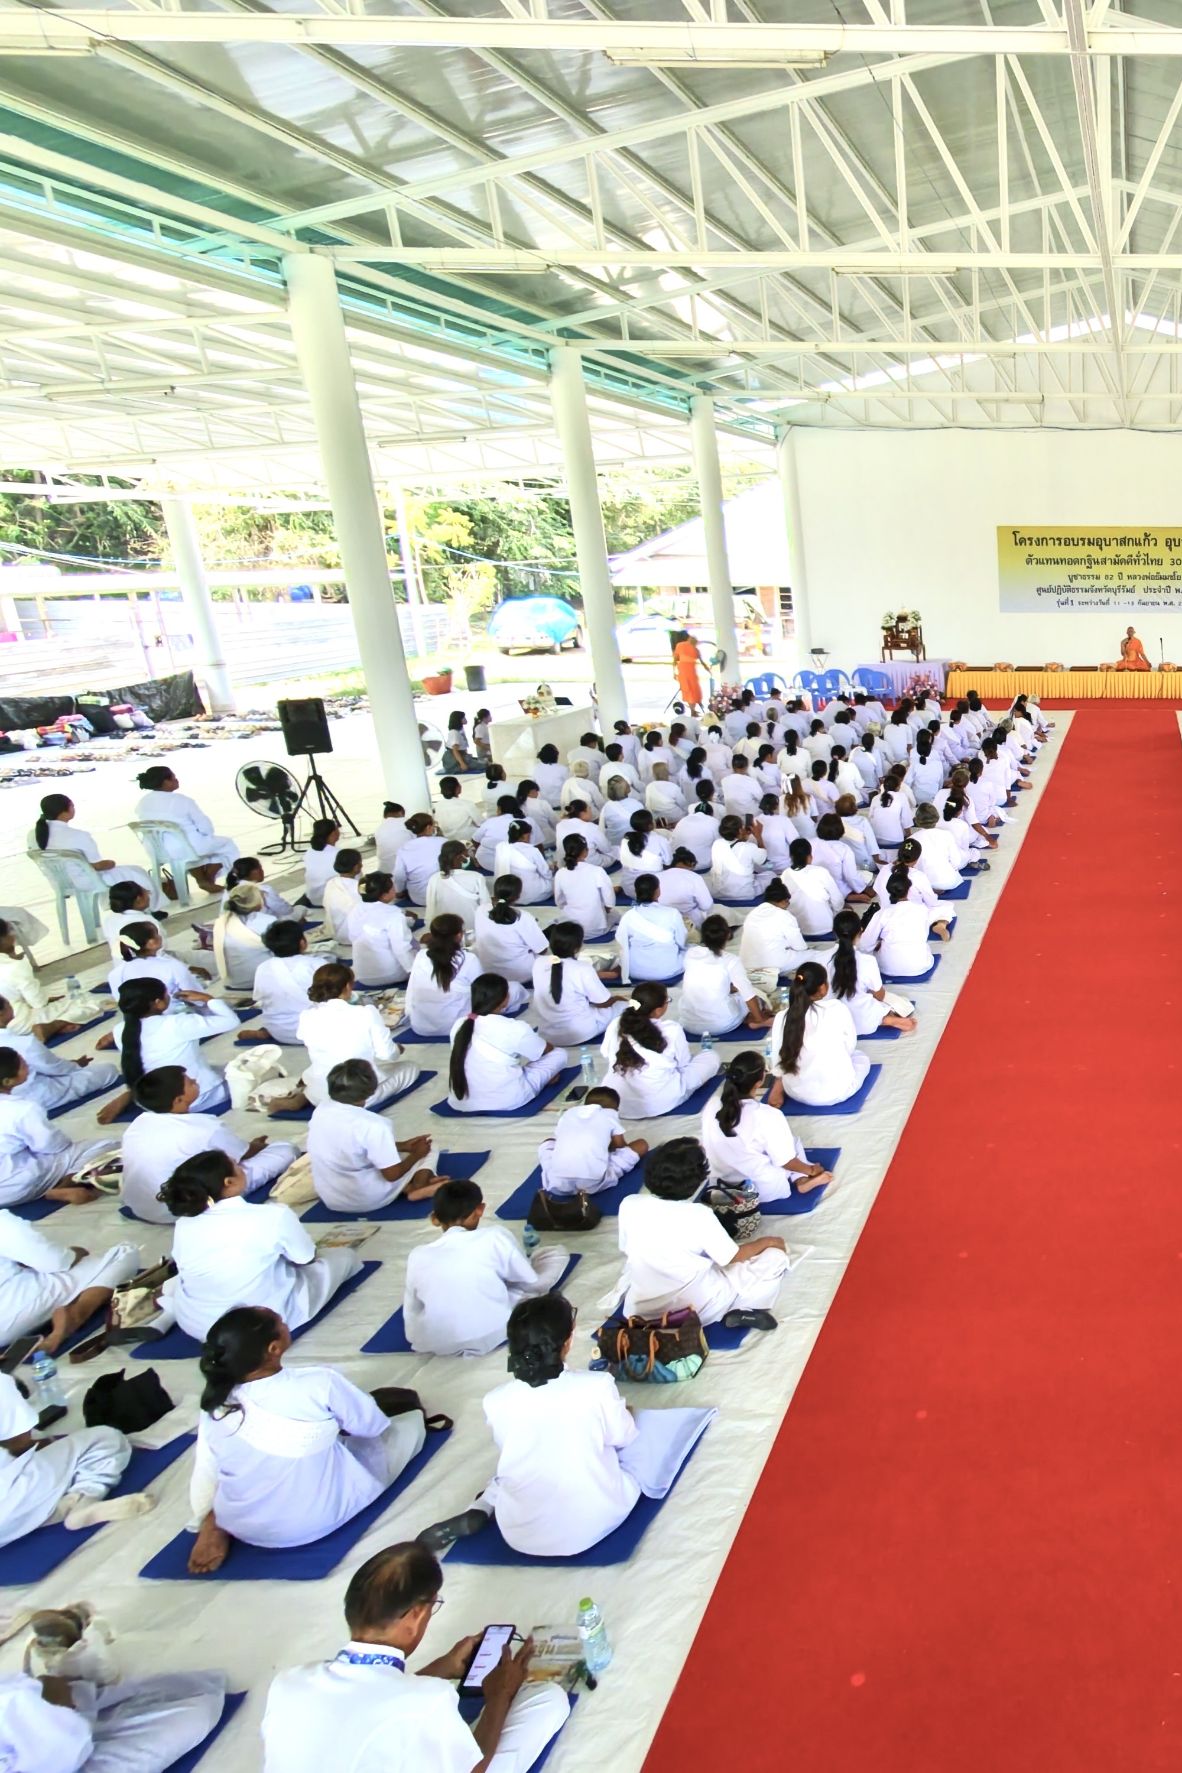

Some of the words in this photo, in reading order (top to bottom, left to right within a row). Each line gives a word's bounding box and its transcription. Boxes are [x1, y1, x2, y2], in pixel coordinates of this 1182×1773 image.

[1012, 531, 1157, 552] โครงการอบรมอุบาสกแก้ว
[1068, 573, 1100, 583] บูชาธรรม
[1117, 572, 1124, 580] ปี
[1143, 585, 1172, 594] ประจำปี
